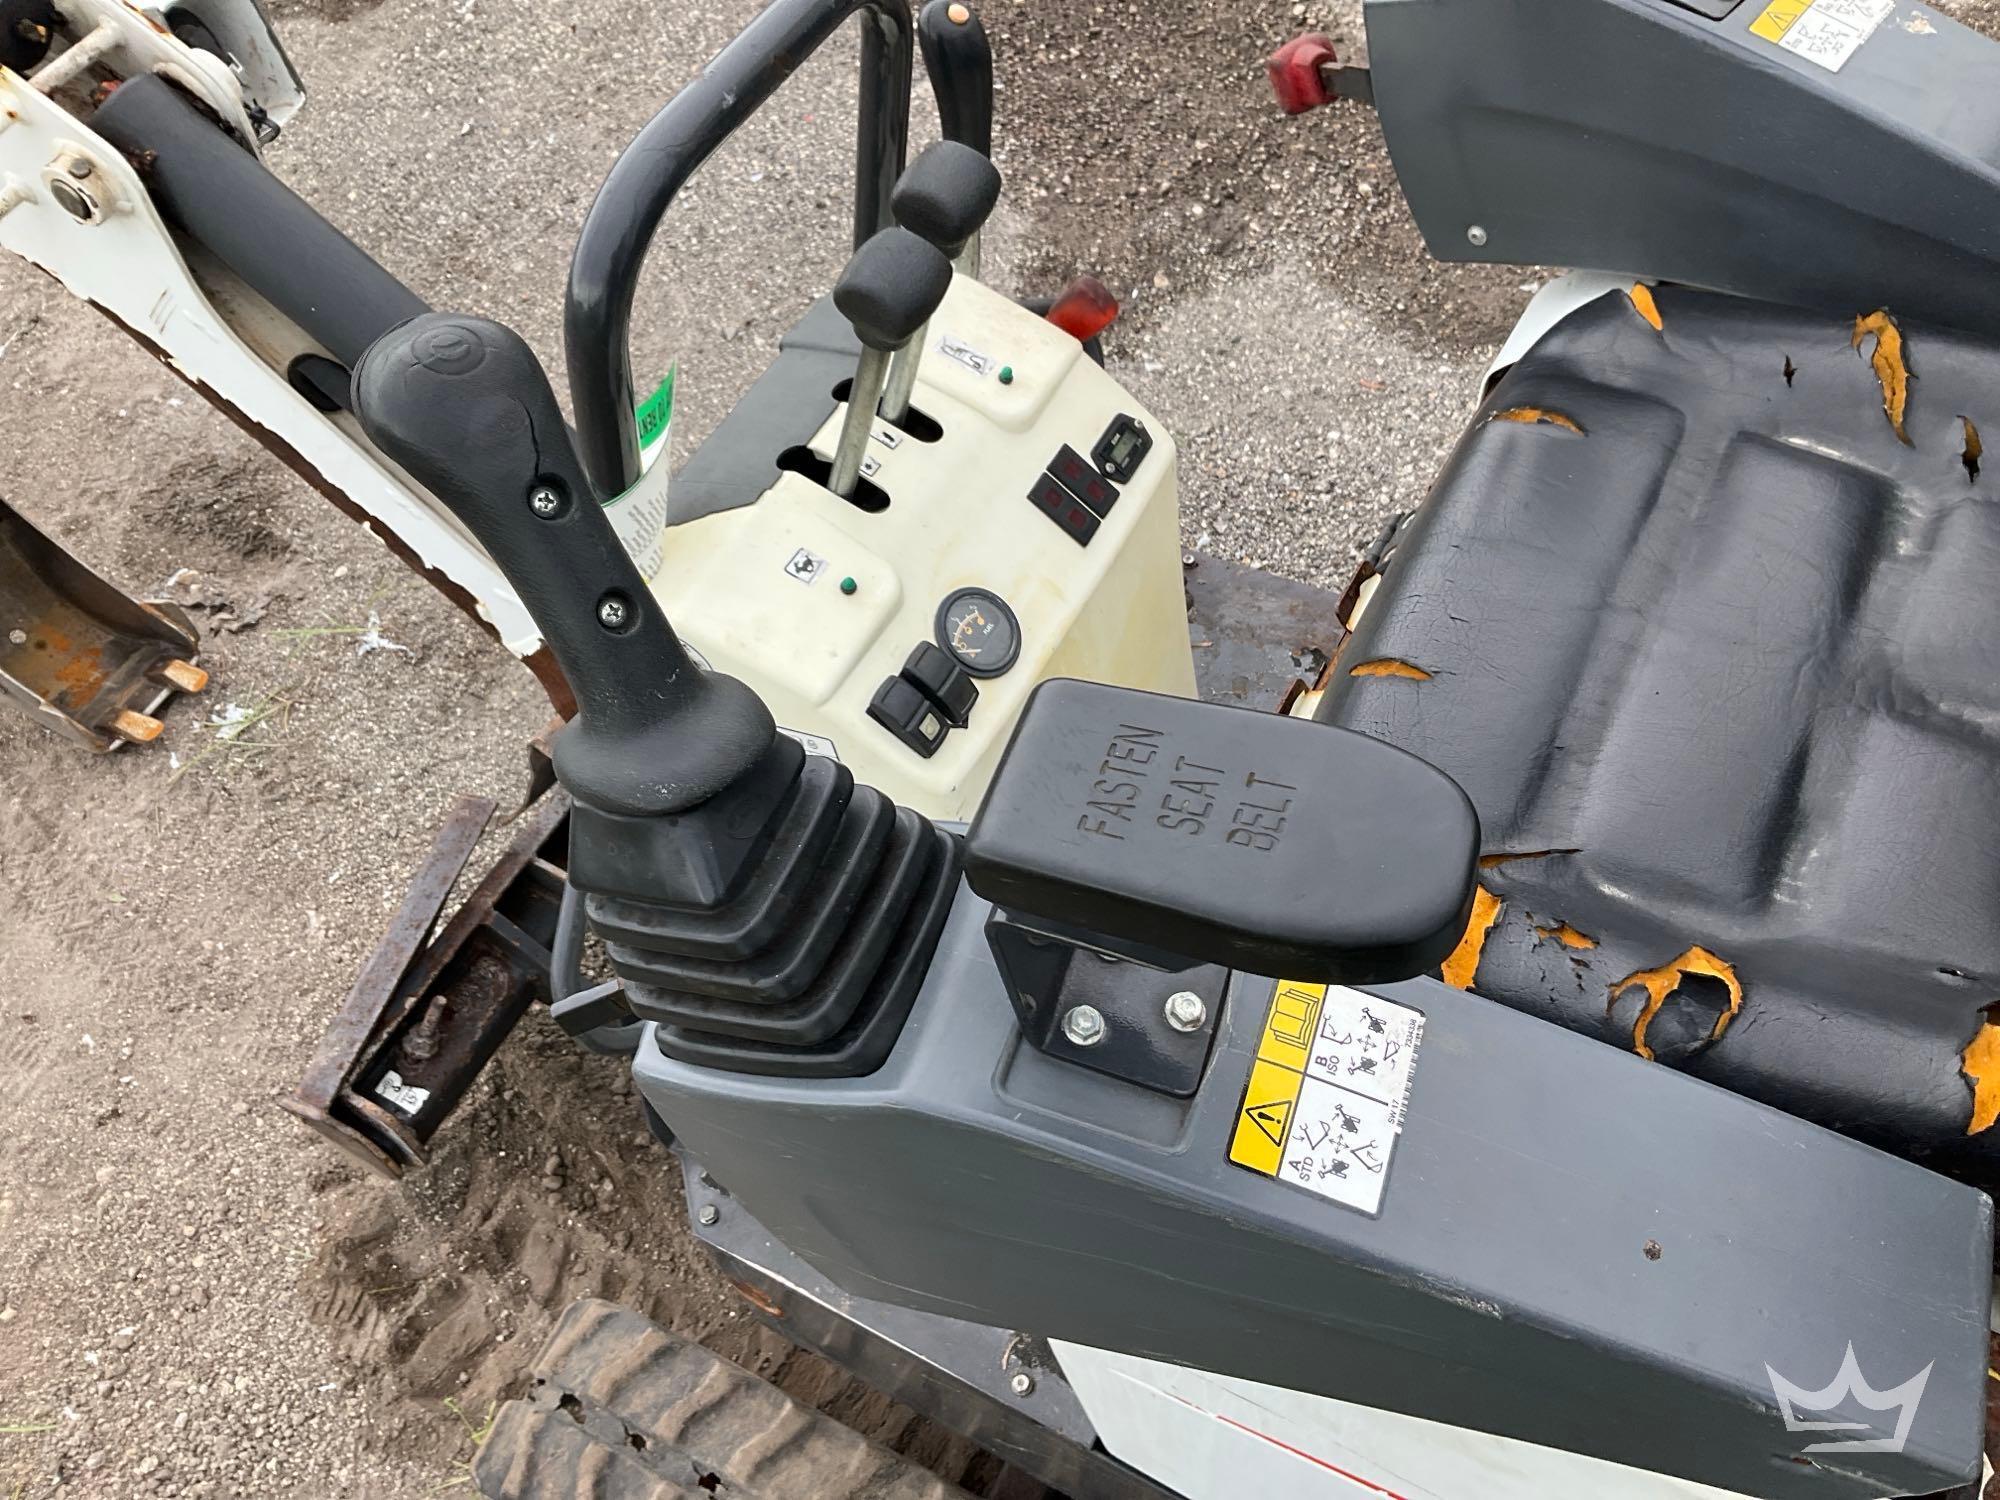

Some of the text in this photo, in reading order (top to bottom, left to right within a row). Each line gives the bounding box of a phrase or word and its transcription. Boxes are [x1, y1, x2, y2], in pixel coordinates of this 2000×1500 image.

[1077, 723, 1165, 840] FASTEN
[1156, 755, 1225, 836] SEAT
[1225, 771, 1297, 851] BELT
[1315, 1055, 1327, 1067] B
[1325, 1055, 1340, 1076] ISO
[1387, 1109, 1397, 1125] SW
[1289, 1160, 1302, 1172] A
[1299, 1156, 1314, 1182] STD
